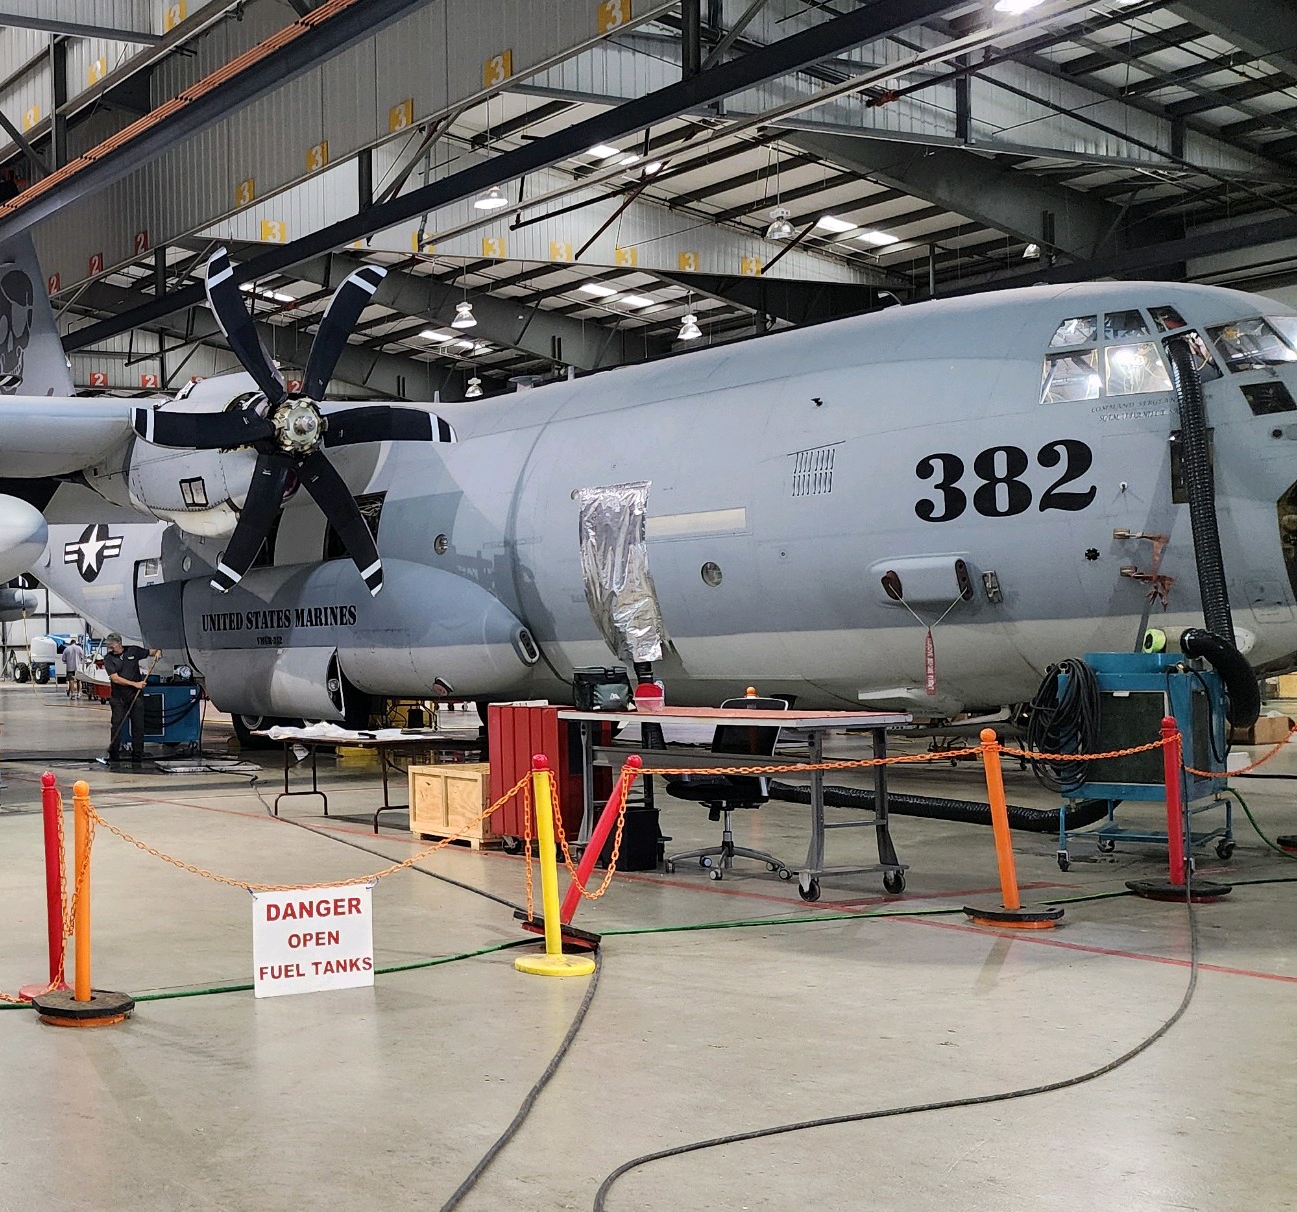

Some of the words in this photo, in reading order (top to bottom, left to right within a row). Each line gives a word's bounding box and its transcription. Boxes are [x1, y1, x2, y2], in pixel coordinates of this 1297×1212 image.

[606, 0, 623, 30] 3
[491, 55, 504, 85] 3
[395, 104, 406, 132] 3
[312, 147, 322, 171] 3
[240, 182, 250, 205] 3
[267, 221, 281, 242] 3
[137, 233, 145, 254] 2
[488, 238, 500, 257] 3
[555, 242, 567, 262] 3
[92, 255, 99, 275] 2
[621, 249, 633, 267] 3
[685, 253, 696, 271] 3
[746, 257, 756, 276] 3
[50, 275, 57, 293] 2
[94, 374, 104, 386] 2
[145, 375, 155, 387] 2
[292, 381, 301, 393] 2
[914, 438, 1097, 523] 382
[202, 612, 243, 632] UNITED
[246, 609, 291, 630] STATES
[294, 605, 357, 628] MARINES
[266, 897, 362, 922] DANGER
[287, 930, 340, 949] OPEN
[259, 963, 306, 980] FUEL
[311, 956, 373, 976] TANKS
